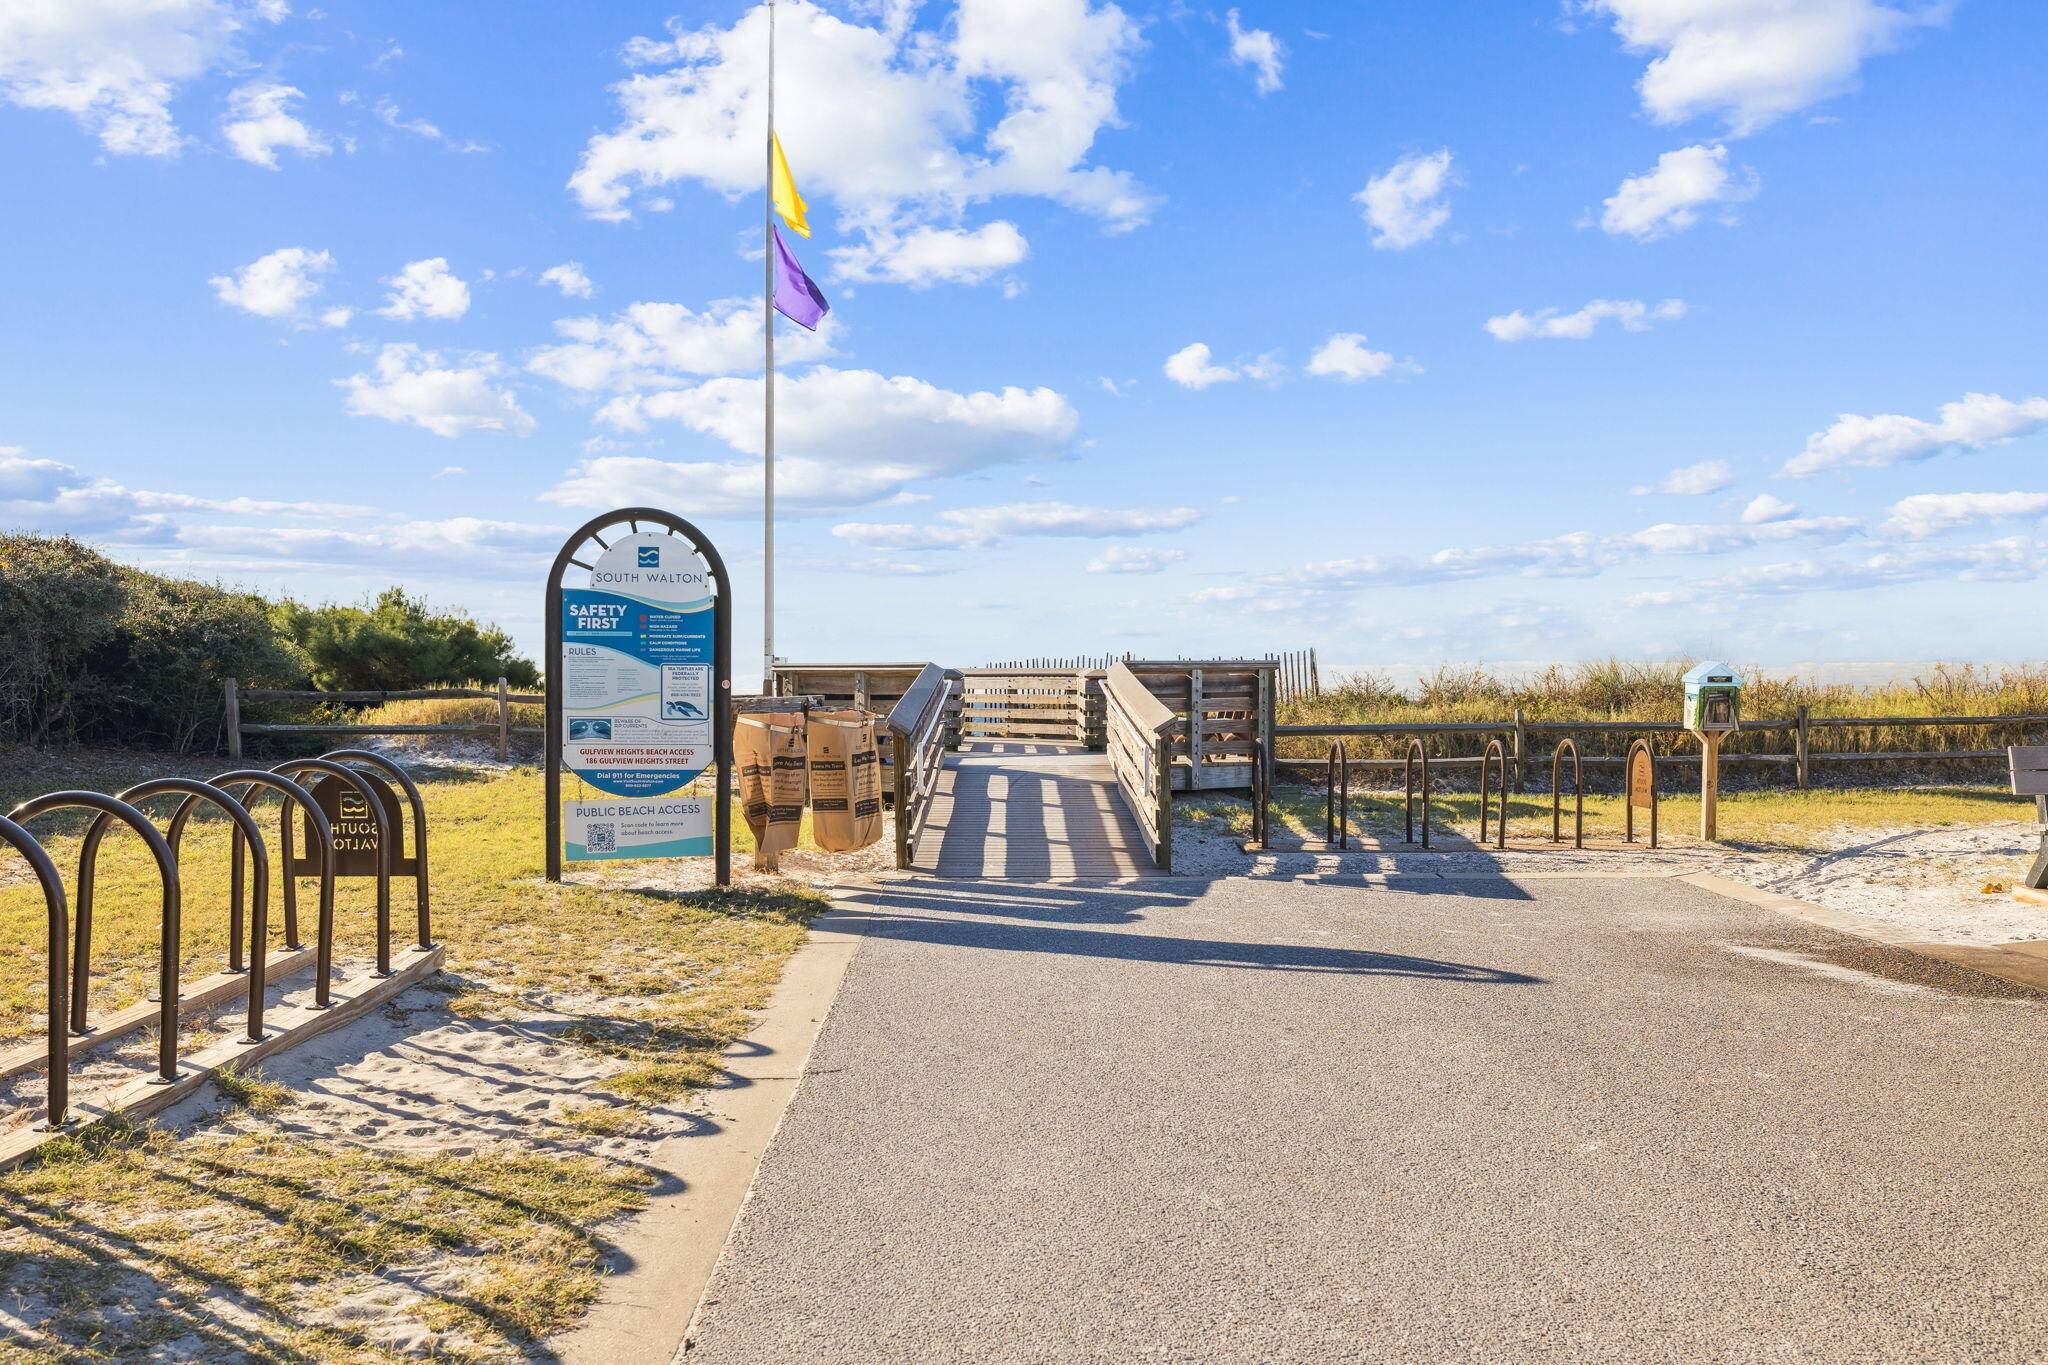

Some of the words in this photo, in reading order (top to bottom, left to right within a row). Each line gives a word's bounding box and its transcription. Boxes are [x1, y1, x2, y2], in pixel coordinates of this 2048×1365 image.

[596, 573, 640, 583] SOUTH
[646, 573, 702, 583] WALTON
[570, 604, 628, 616] SAFETY
[578, 618, 619, 630] FIRST
[576, 807, 615, 817] PUBLIC
[619, 806, 655, 816] BEACH
[658, 805, 700, 814] ACCESS
